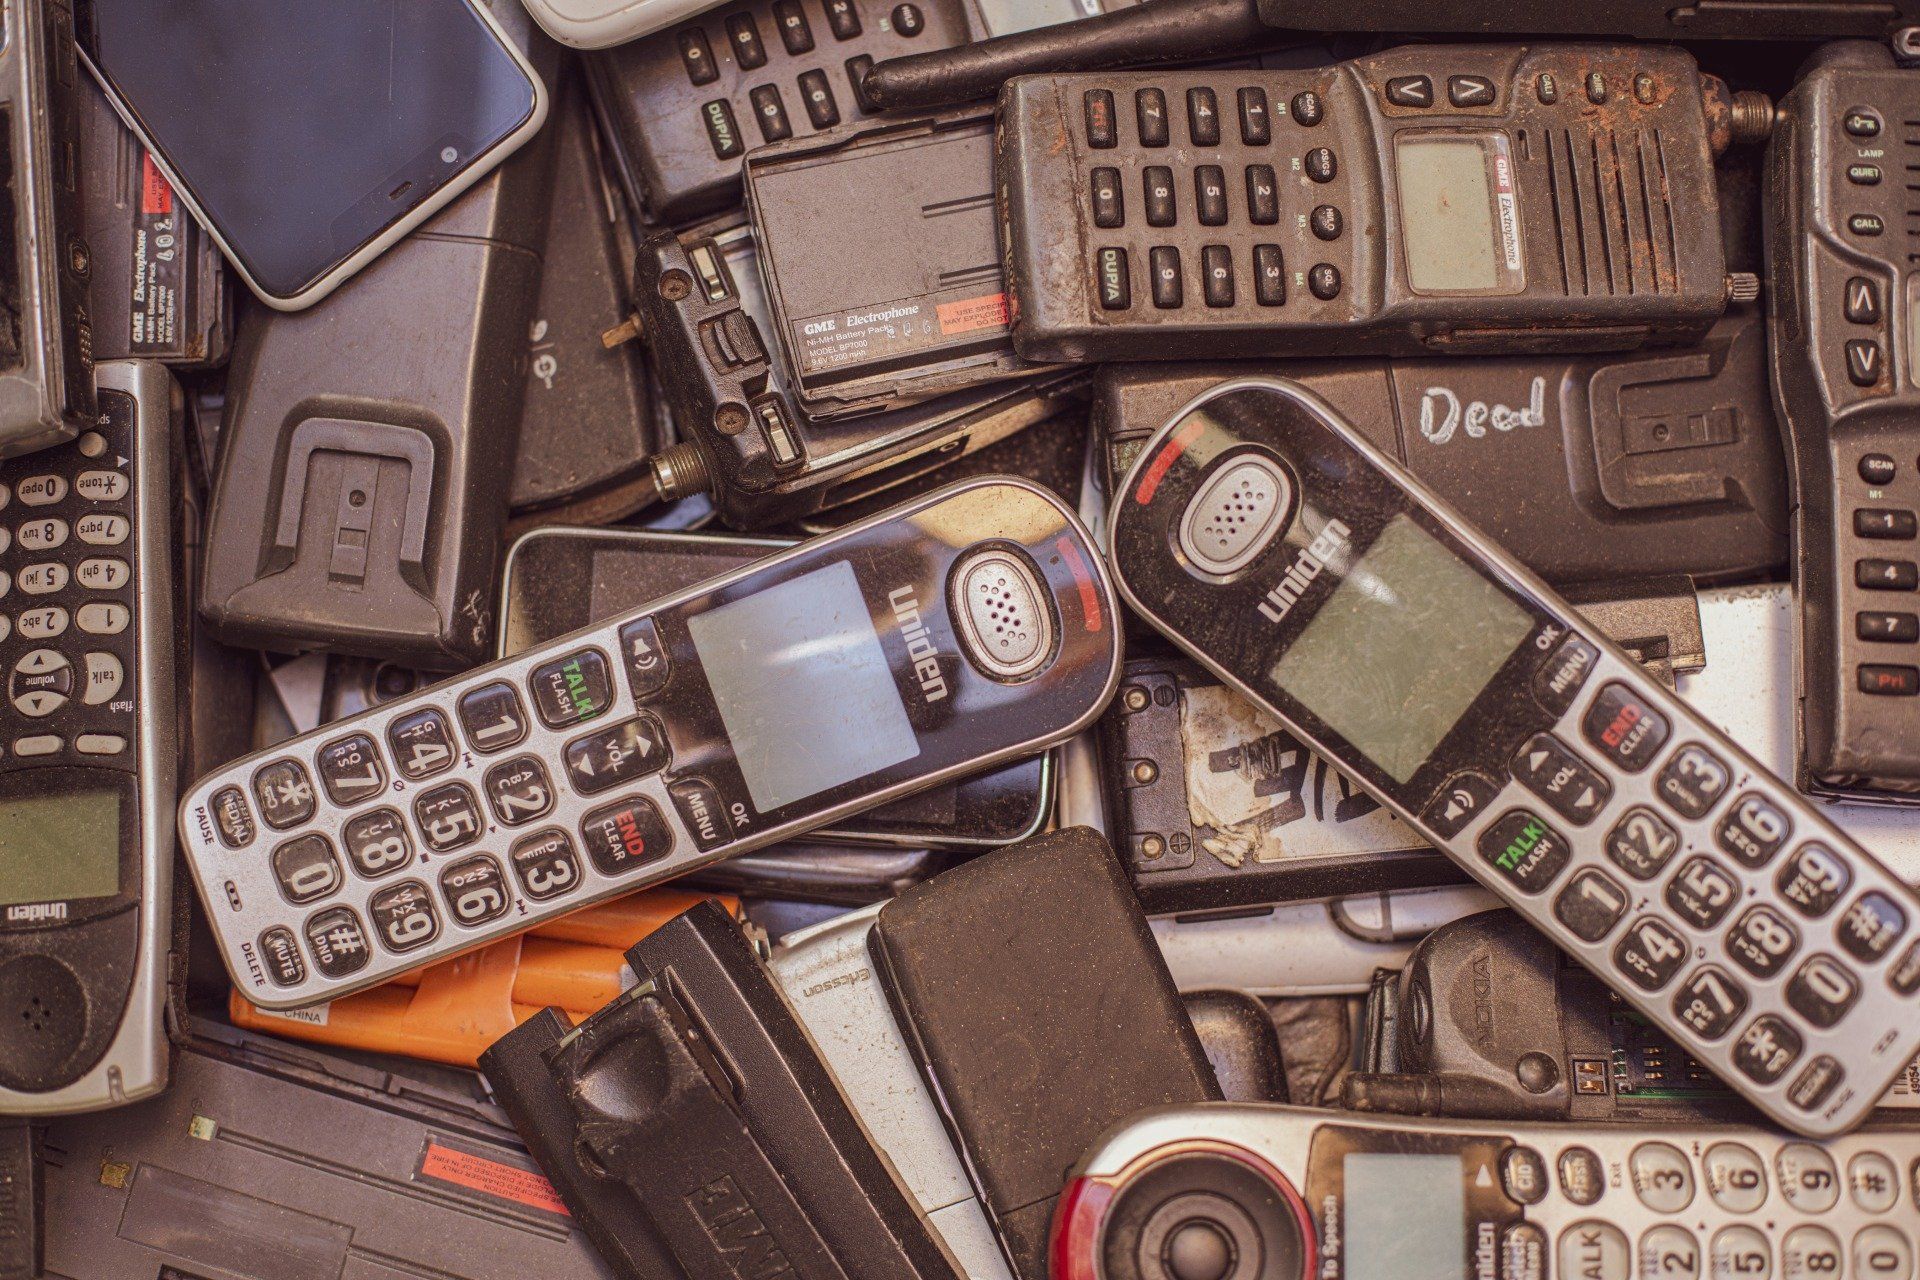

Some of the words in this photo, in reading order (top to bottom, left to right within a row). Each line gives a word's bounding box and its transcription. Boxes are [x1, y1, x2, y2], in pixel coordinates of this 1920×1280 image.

[833, 2, 847, 14] 2
[786, 15, 800, 28] 5
[738, 31, 752, 43] 8
[687, 48, 701, 59] 0
[812, 89, 826, 103] 6
[1304, 93, 1316, 118] SCAN
[764, 103, 778, 117] 9
[1146, 107, 1160, 118] 7
[1198, 105, 1212, 117] 4
[1250, 105, 1263, 114] 1
[1277, 102, 1287, 116] M1
[707, 102, 734, 152] DUP/A
[1290, 157, 1301, 172] M2
[1319, 148, 1331, 176] OS/GS
[1858, 149, 1885, 158] LAMP
[1850, 168, 1879, 178] QUIET
[1099, 188, 1113, 200] 0
[1154, 187, 1168, 198] 8
[1206, 185, 1220, 197] 5
[1257, 185, 1272, 196] 2
[1297, 214, 1307, 228] M3
[1325, 207, 1336, 232] HI/LO
[1854, 219, 1880, 229] CALL
[1500, 197, 1518, 265] Electrophone
[134, 229, 147, 302] Electrophone
[149, 262, 157, 284] Pack
[1103, 250, 1120, 302] DUP/A
[1161, 268, 1176, 280] 9
[1213, 267, 1228, 279] 6
[1266, 266, 1280, 278] 3
[1323, 268, 1334, 287] SQL
[148, 285, 157, 315] Battery
[804, 319, 836, 336] GME
[846, 304, 920, 328] Electrophone
[954, 307, 975, 317] USE
[963, 309, 1002, 323] EXPLODE
[975, 319, 990, 327] DO
[132, 312, 144, 344] GME
[147, 316, 155, 343] Ni-MH
[157, 315, 165, 343] MODEL
[807, 335, 835, 348] Ni-MH
[835, 329, 867, 344] Battery
[867, 323, 890, 336] Pack
[809, 346, 838, 358] MODEL
[838, 339, 868, 353] BP7000
[811, 354, 829, 367] 9.6V
[829, 352, 848, 363] 1200
[1420, 376, 1546, 445] Dead
[1868, 459, 1894, 471] SCAN
[21, 484, 43, 496] oper
[46, 478, 56, 497] 0
[79, 478, 103, 489] tone
[1869, 490, 1882, 499] M1
[44, 522, 55, 542] 8
[80, 520, 103, 534] pqrs
[106, 519, 116, 539] 7
[1884, 514, 1894, 528] 1
[22, 528, 39, 540] tuv
[25, 569, 39, 586] jkl
[46, 566, 56, 586] 5
[83, 564, 99, 580] ghi
[105, 564, 117, 583] 4
[1256, 517, 1352, 624] Uniden
[1884, 565, 1898, 580] 4
[22, 615, 41, 629] abc
[45, 611, 57, 631] 2
[106, 608, 114, 628] 1
[1886, 618, 1899, 632] 7
[888, 584, 948, 703] Uniden
[1535, 624, 1560, 651] OK
[25, 674, 56, 687] volume
[91, 669, 115, 685] talk
[1550, 648, 1590, 694] MENU
[549, 672, 573, 716] FLASH
[563, 658, 595, 718] TALK
[109, 699, 134, 714] flash
[400, 720, 437, 739] GHI
[476, 714, 518, 741] 1
[1601, 703, 1642, 749] END
[1619, 715, 1655, 756] CLEAR
[406, 742, 449, 771] 4
[604, 738, 624, 773] VOL
[334, 761, 380, 789] 7
[497, 770, 534, 790] ABC
[1547, 765, 1578, 793] VOL
[1678, 751, 1721, 793] 3
[425, 797, 462, 815] JKL
[501, 785, 547, 821] 2
[194, 805, 215, 846] PAUSE
[222, 792, 249, 843] REDIAL
[688, 791, 717, 842] MENU
[730, 801, 750, 829] OK
[1739, 800, 1783, 843] 6
[356, 819, 394, 839] TUV
[428, 809, 476, 844] 5
[614, 808, 645, 856] END
[1626, 815, 1674, 860] 2
[602, 819, 627, 861] CLEAR
[1496, 821, 1544, 872] TALK
[361, 835, 406, 870] 8
[1516, 837, 1554, 878] FLASH
[291, 861, 334, 895] 0
[452, 867, 490, 887] MNO
[527, 859, 572, 893] 3
[1798, 849, 1844, 893] 9
[1581, 877, 1621, 912] 1
[1682, 863, 1731, 907] 5
[7, 901, 67, 922] Uniden
[457, 888, 500, 919] 6
[388, 912, 434, 944] 9
[1746, 911, 1793, 955] 8
[315, 935, 334, 964] DND
[329, 927, 359, 954] #
[1638, 924, 1682, 963] 4
[241, 942, 266, 987] DELETE
[274, 938, 297, 978] MUTE
[1692, 972, 1735, 1015] 7
[1803, 963, 1852, 1004] 0
[284, 1010, 321, 1023] CHINA
[431, 1154, 449, 1164] FIRE
[524, 1175, 541, 1184] NOT
[1653, 1168, 1684, 1190] 3
[1728, 1168, 1760, 1190] 6
[1800, 1168, 1832, 1190] 9
[484, 1184, 520, 1199] CAUTION
[1321, 1195, 1342, 1256] Speech
[1662, 1251, 1695, 1273] 2
[1734, 1252, 1766, 1273] 5
[1806, 1251, 1837, 1273] 8
[1869, 1251, 1900, 1273] 0
